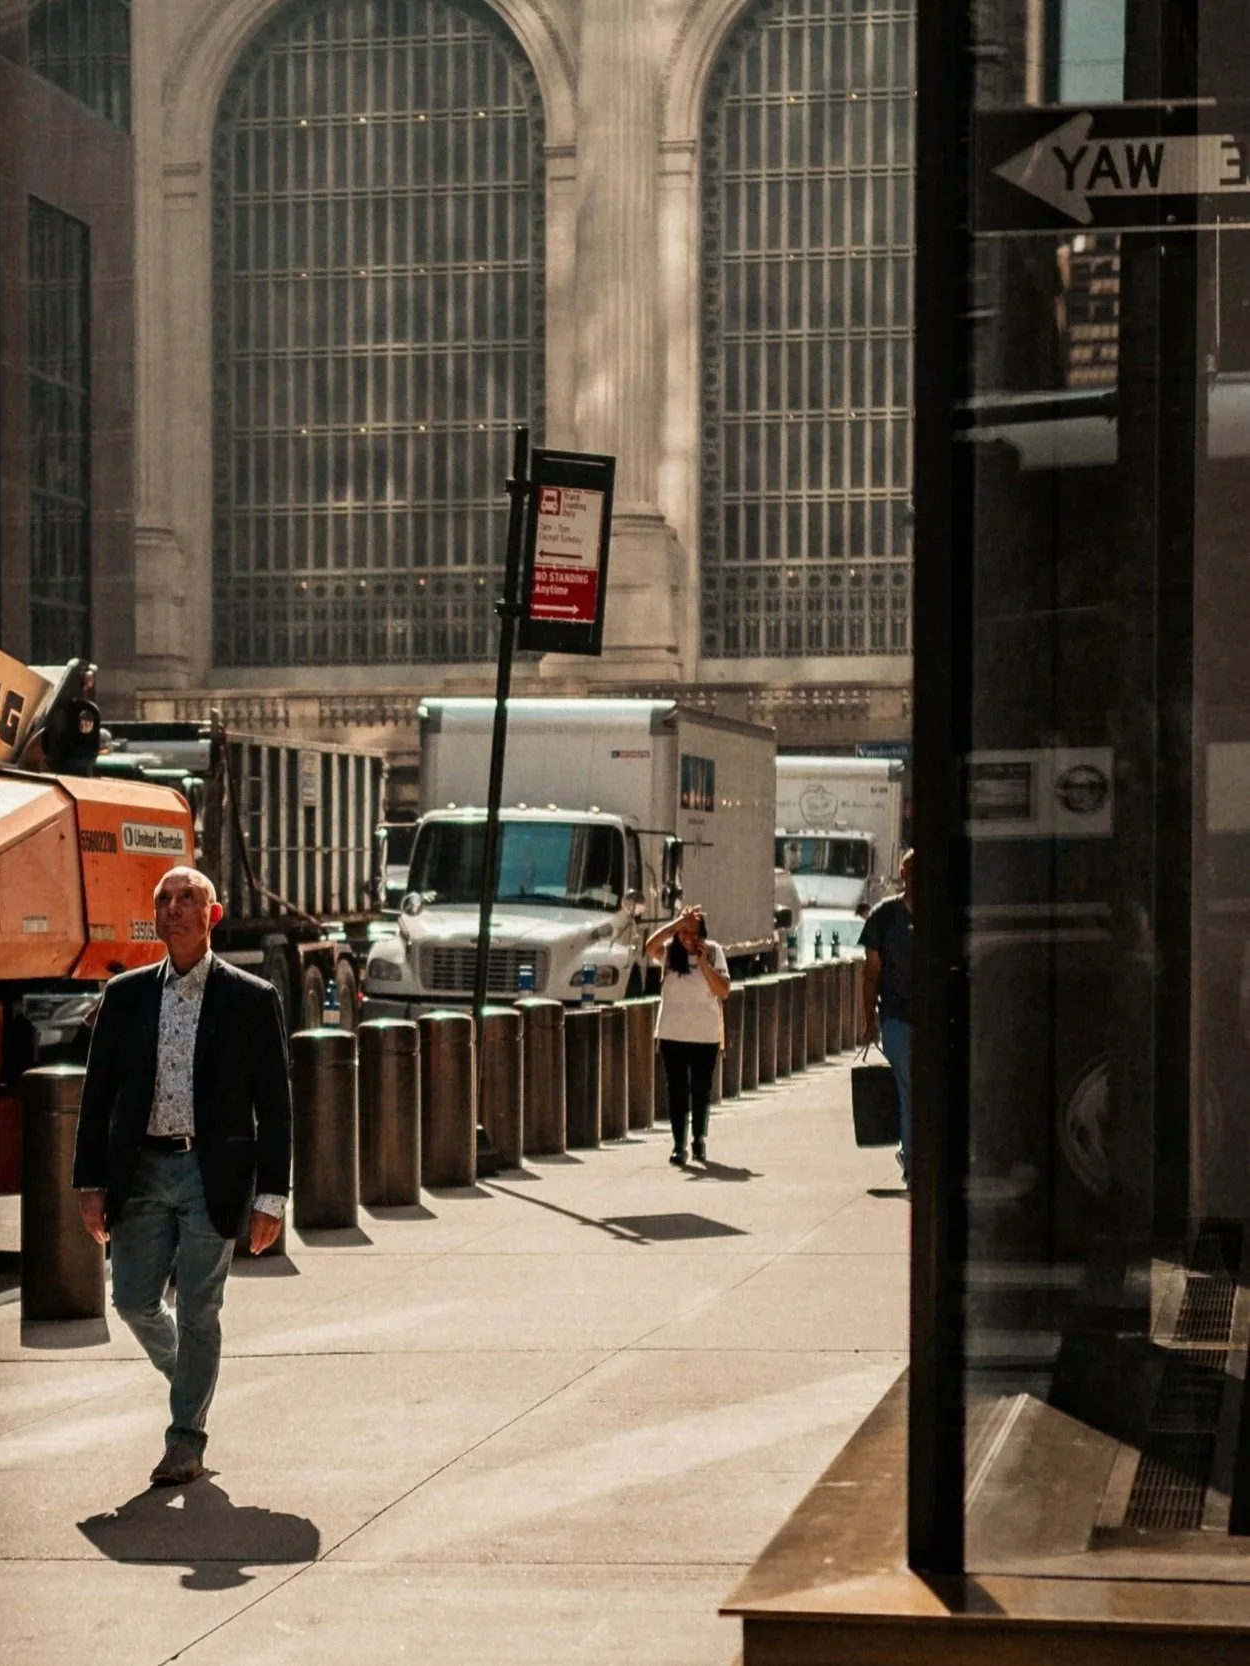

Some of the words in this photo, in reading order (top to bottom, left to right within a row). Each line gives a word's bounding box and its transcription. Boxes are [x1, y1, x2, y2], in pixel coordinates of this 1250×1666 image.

[535, 570, 548, 582] NO
[549, 571, 589, 585] STANDING
[534, 583, 569, 596] Anytime
[134, 829, 157, 849] United
[158, 831, 183, 850] Rentals
